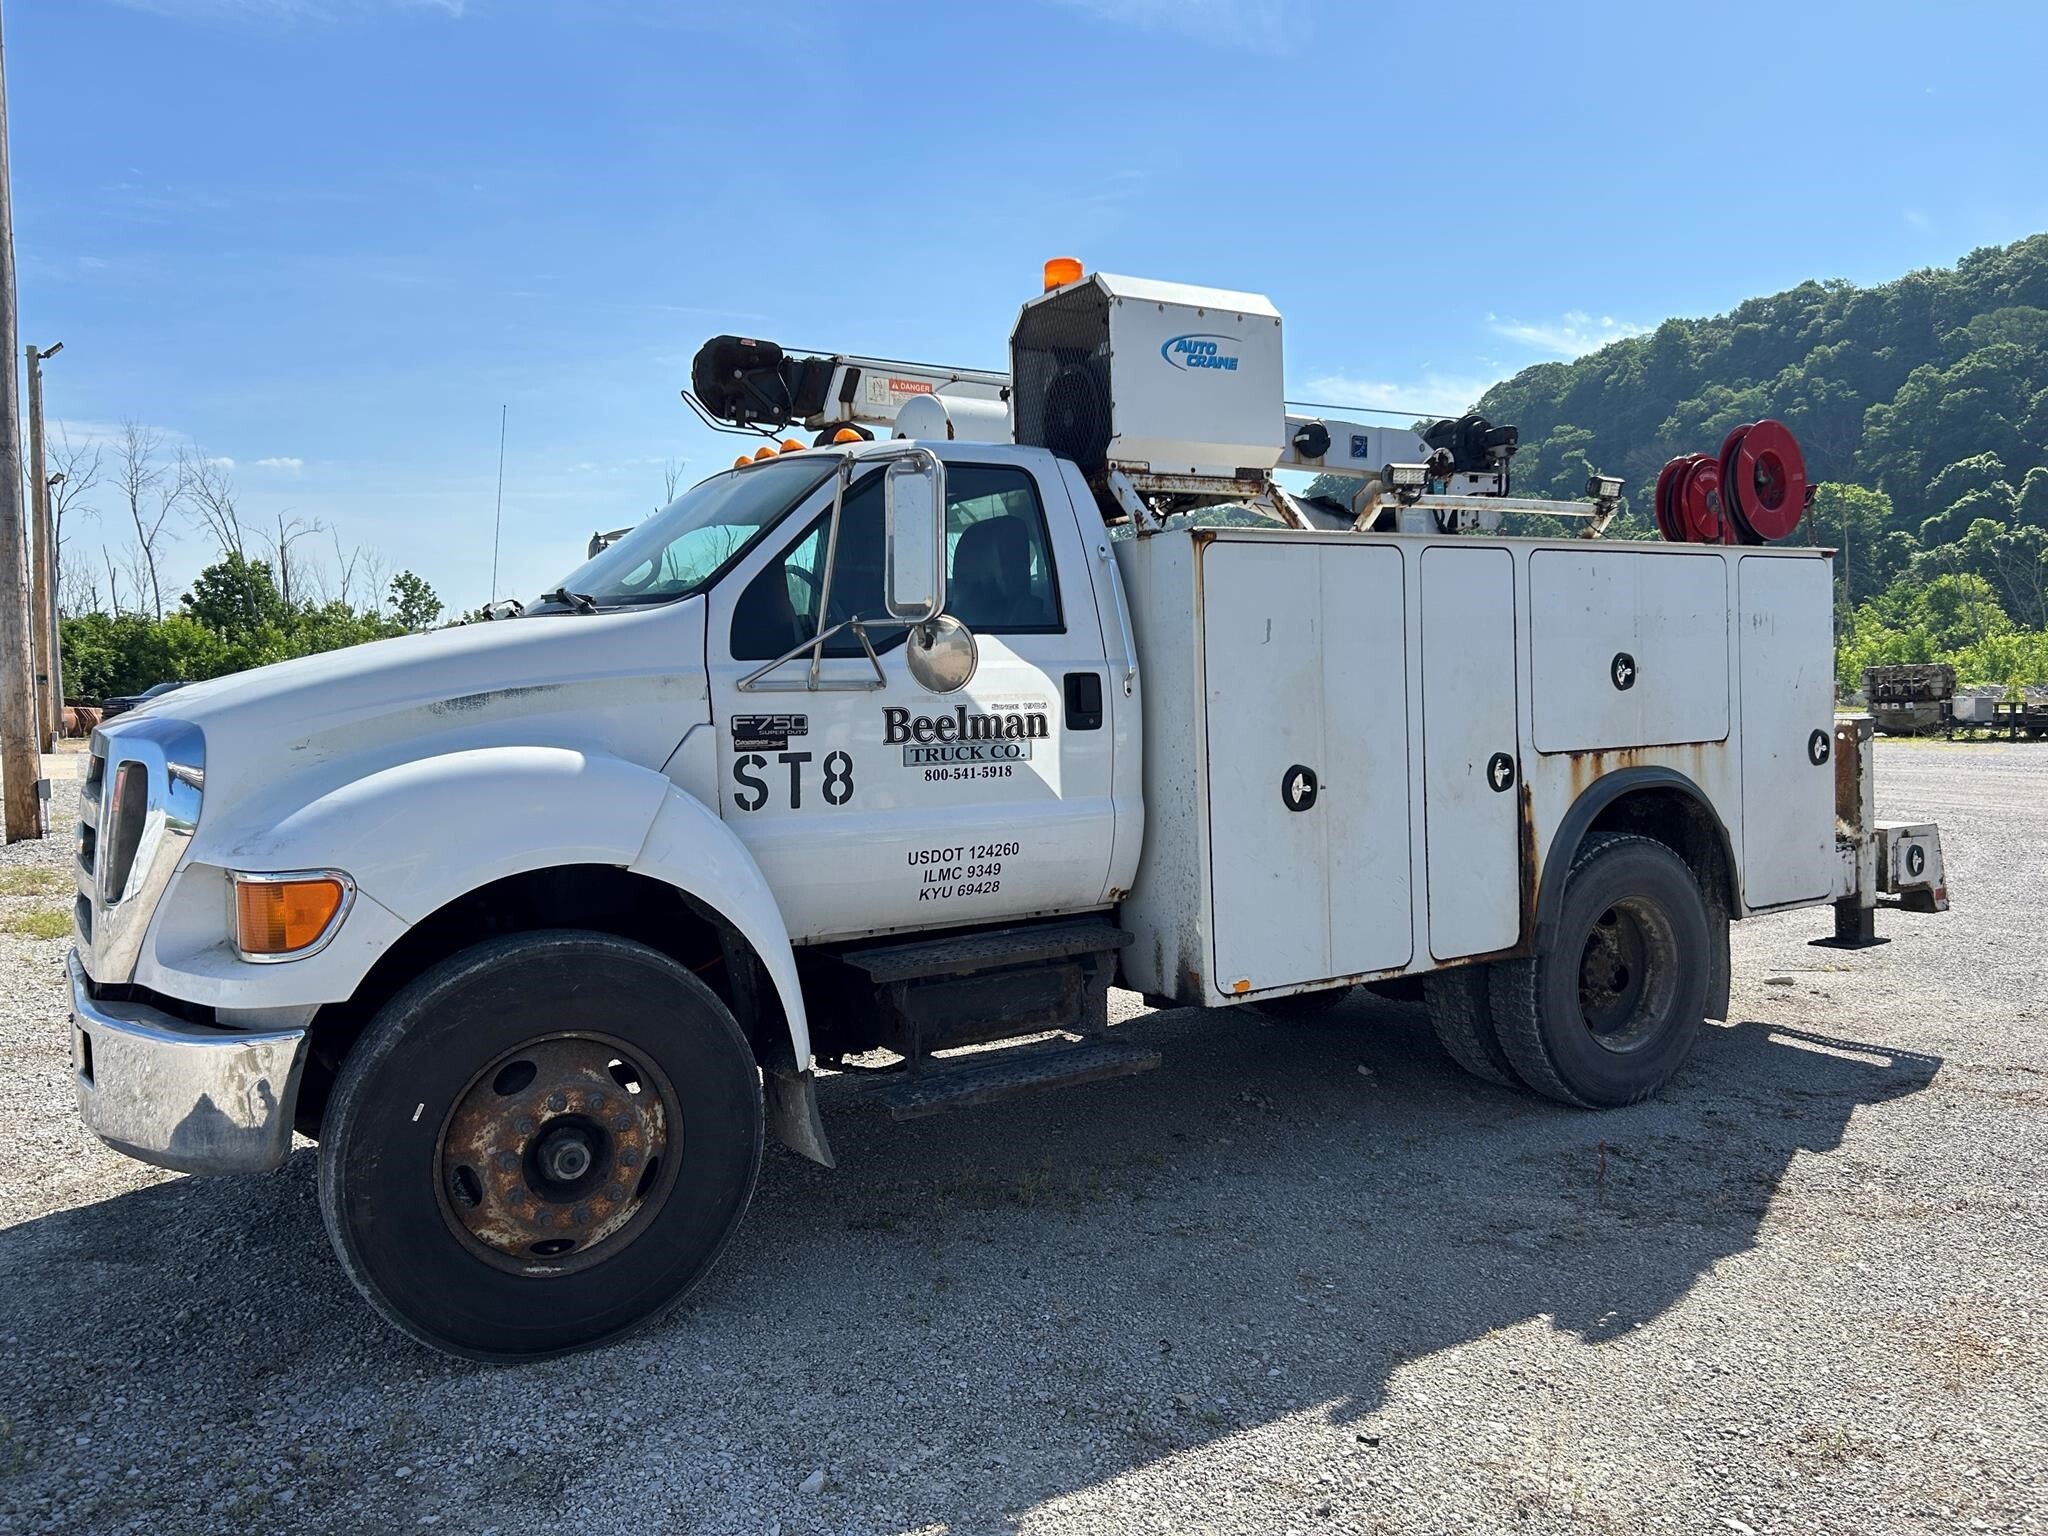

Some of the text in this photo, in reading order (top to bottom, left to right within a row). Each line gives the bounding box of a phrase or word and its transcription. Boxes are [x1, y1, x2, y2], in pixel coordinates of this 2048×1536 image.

[1174, 340, 1217, 355] AUTO
[1186, 354, 1239, 370] CRANE
[900, 382, 931, 393] DANGER
[882, 705, 1050, 745] Beelman
[910, 743, 1026, 763] TRUCK CO.
[733, 751, 854, 811] ST8
[924, 765, 1013, 782] 800-541-5918
[908, 842, 1020, 866] USDOT 124260
[923, 862, 1002, 883] ILMC 9349
[919, 880, 1001, 901] KYU 69428
